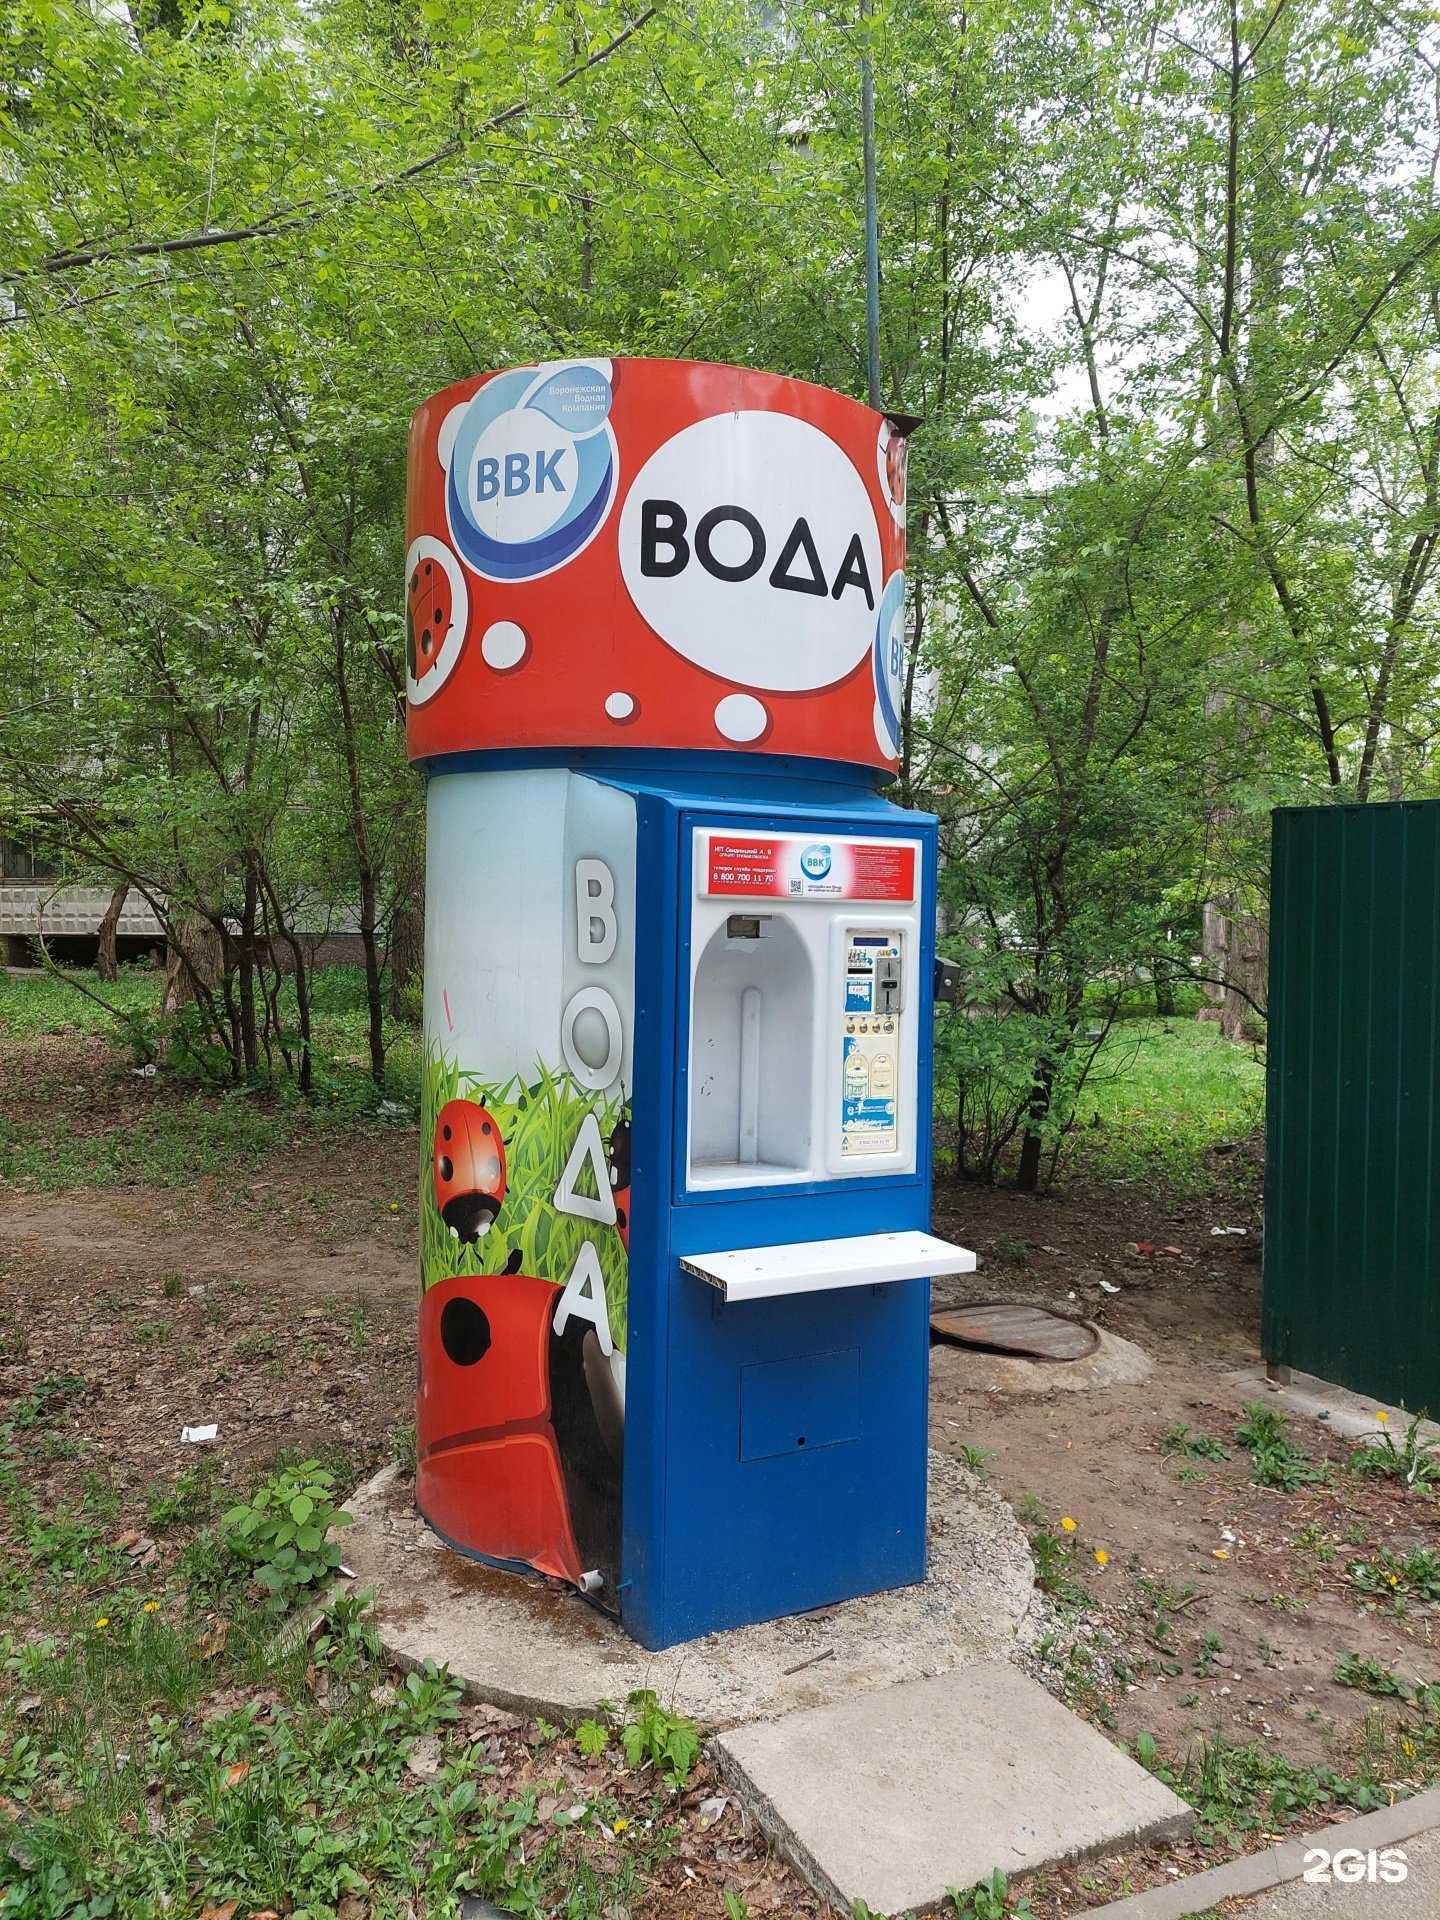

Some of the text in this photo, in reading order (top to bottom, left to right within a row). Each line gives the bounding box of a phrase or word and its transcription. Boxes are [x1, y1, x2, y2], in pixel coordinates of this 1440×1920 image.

[574, 393, 606, 404] Водная
[476, 448, 567, 502] ВВК
[640, 499, 875, 611] ВОДА
[736, 873, 751, 882] 700
[753, 874, 762, 882] 11
[764, 874, 774, 883] 70
[808, 857, 825, 867] ВВК
[553, 858, 624, 1357] ВОДА
